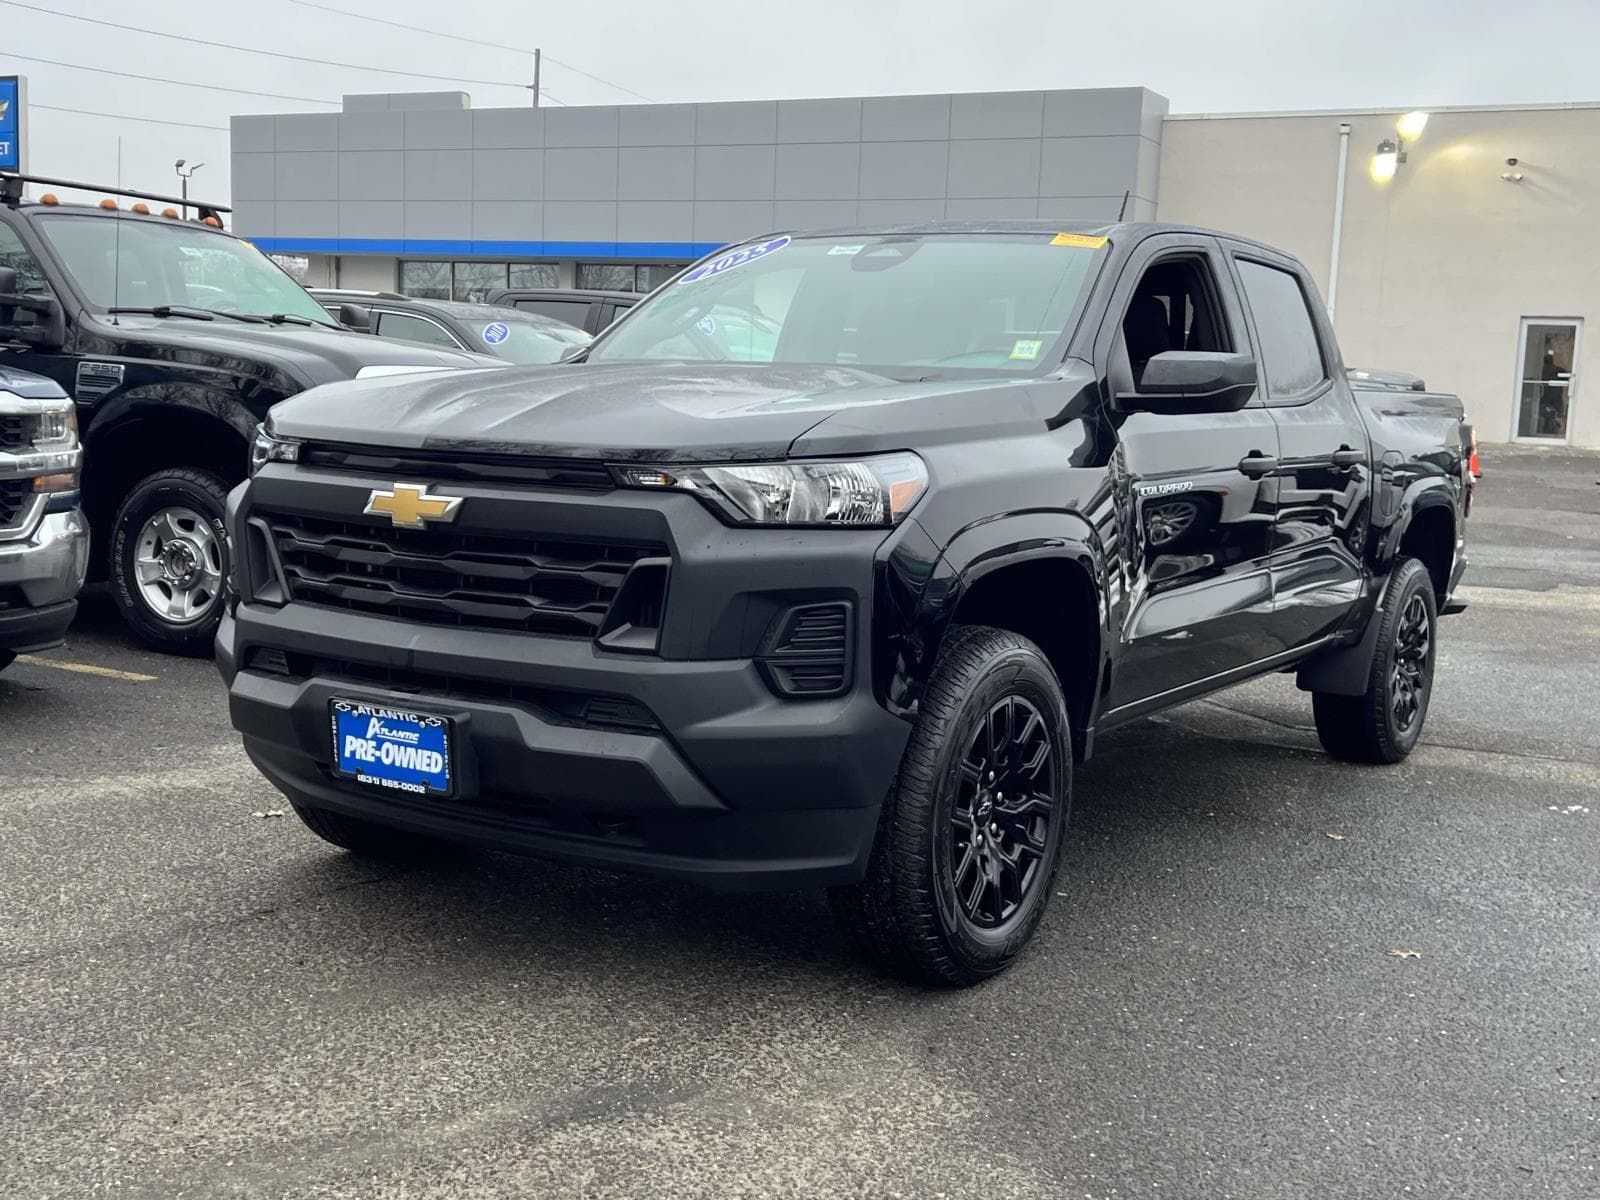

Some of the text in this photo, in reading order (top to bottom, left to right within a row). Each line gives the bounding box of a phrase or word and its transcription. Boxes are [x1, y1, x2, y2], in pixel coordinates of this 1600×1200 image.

[357, 705, 419, 723] ATLANTIC
[344, 735, 443, 773] PRE-OWNED
[357, 774, 380, 785] (631)
